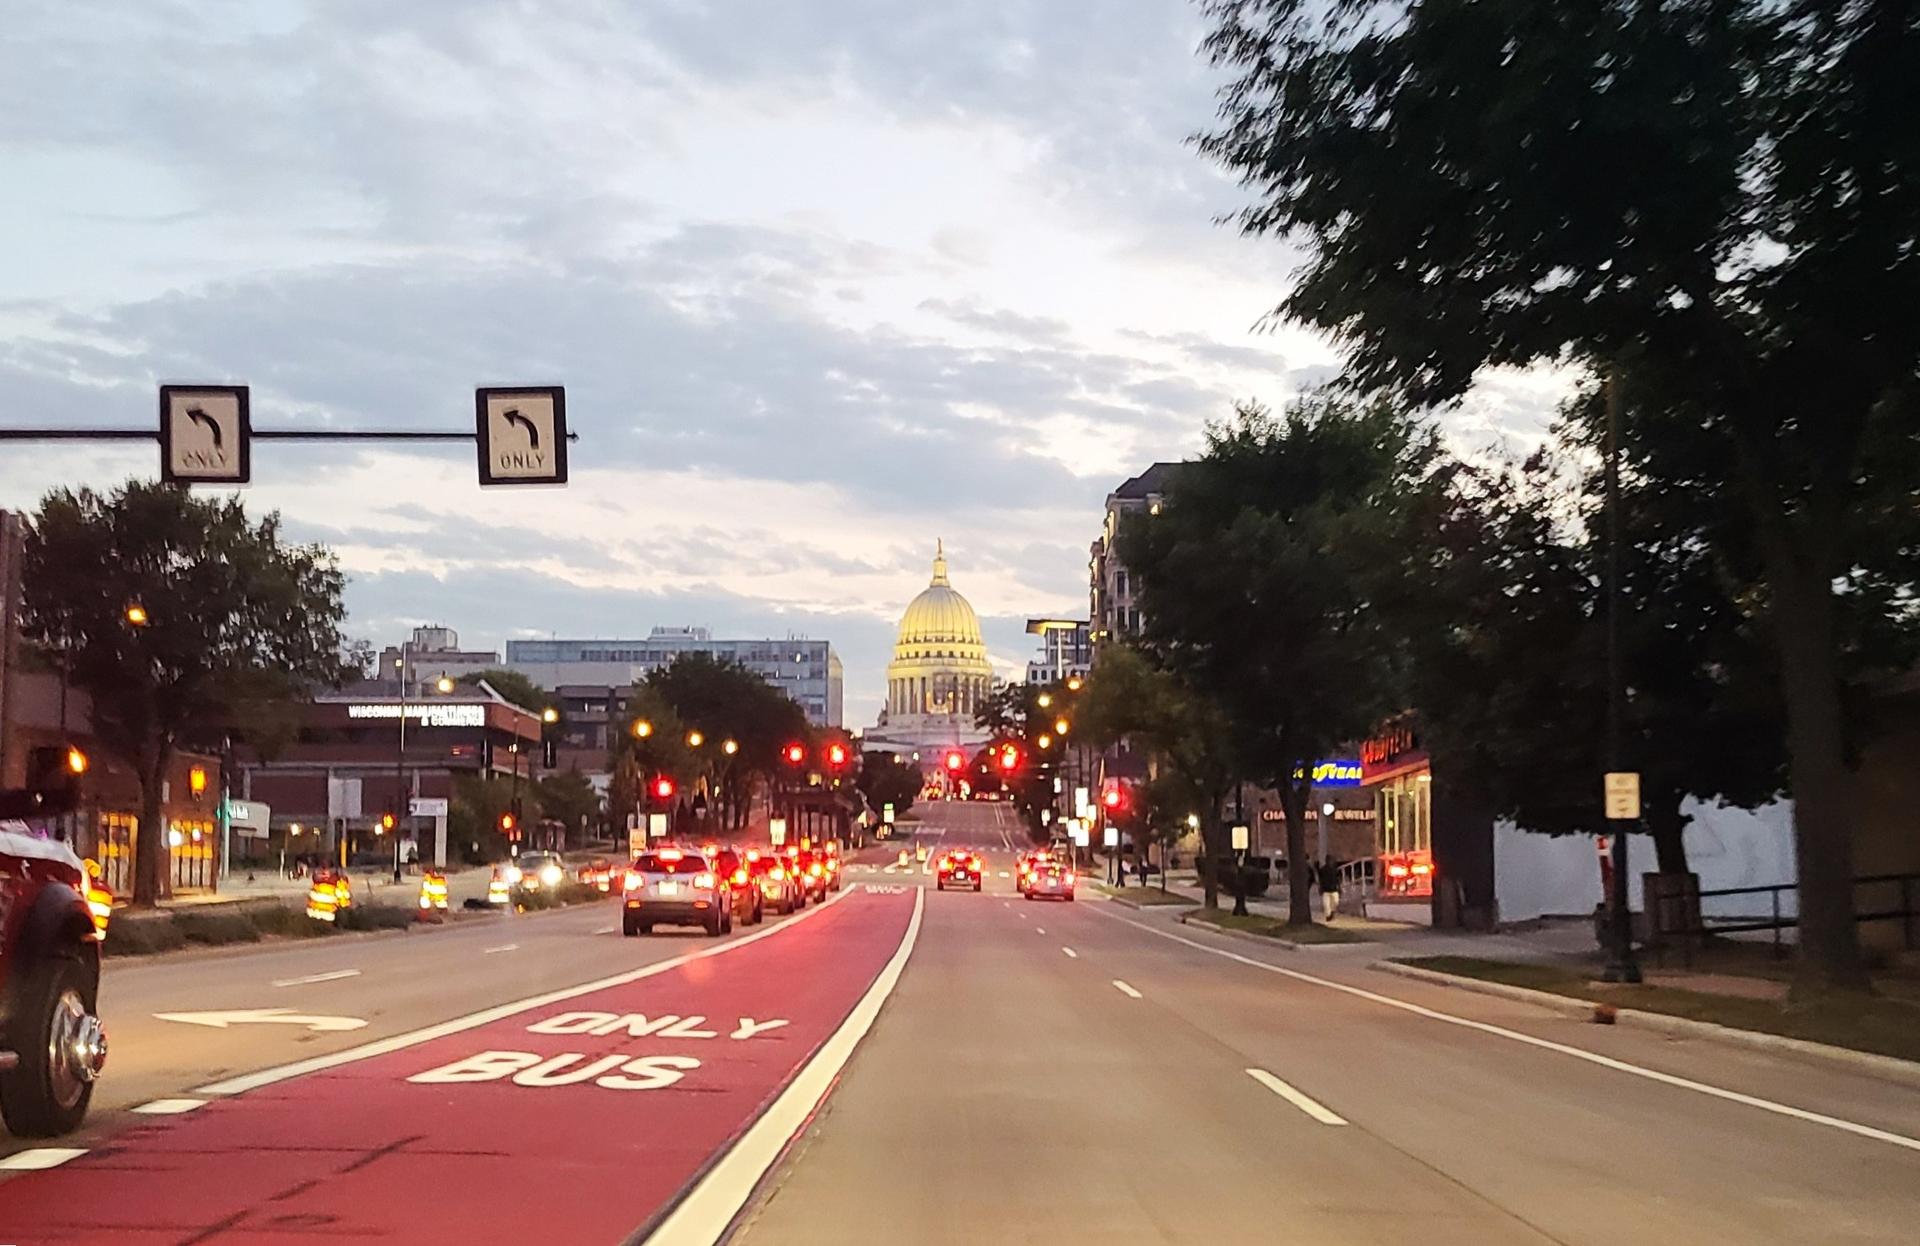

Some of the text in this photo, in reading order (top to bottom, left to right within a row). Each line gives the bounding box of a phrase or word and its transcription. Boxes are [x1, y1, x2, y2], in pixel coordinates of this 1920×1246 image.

[500, 451, 545, 470] ONLY
[348, 705, 485, 718] WISCONSIN MANUFACTURERS
[1263, 809, 1318, 821] CHARS
[526, 1011, 791, 1040] ONLY
[405, 1050, 702, 1091] BUS
